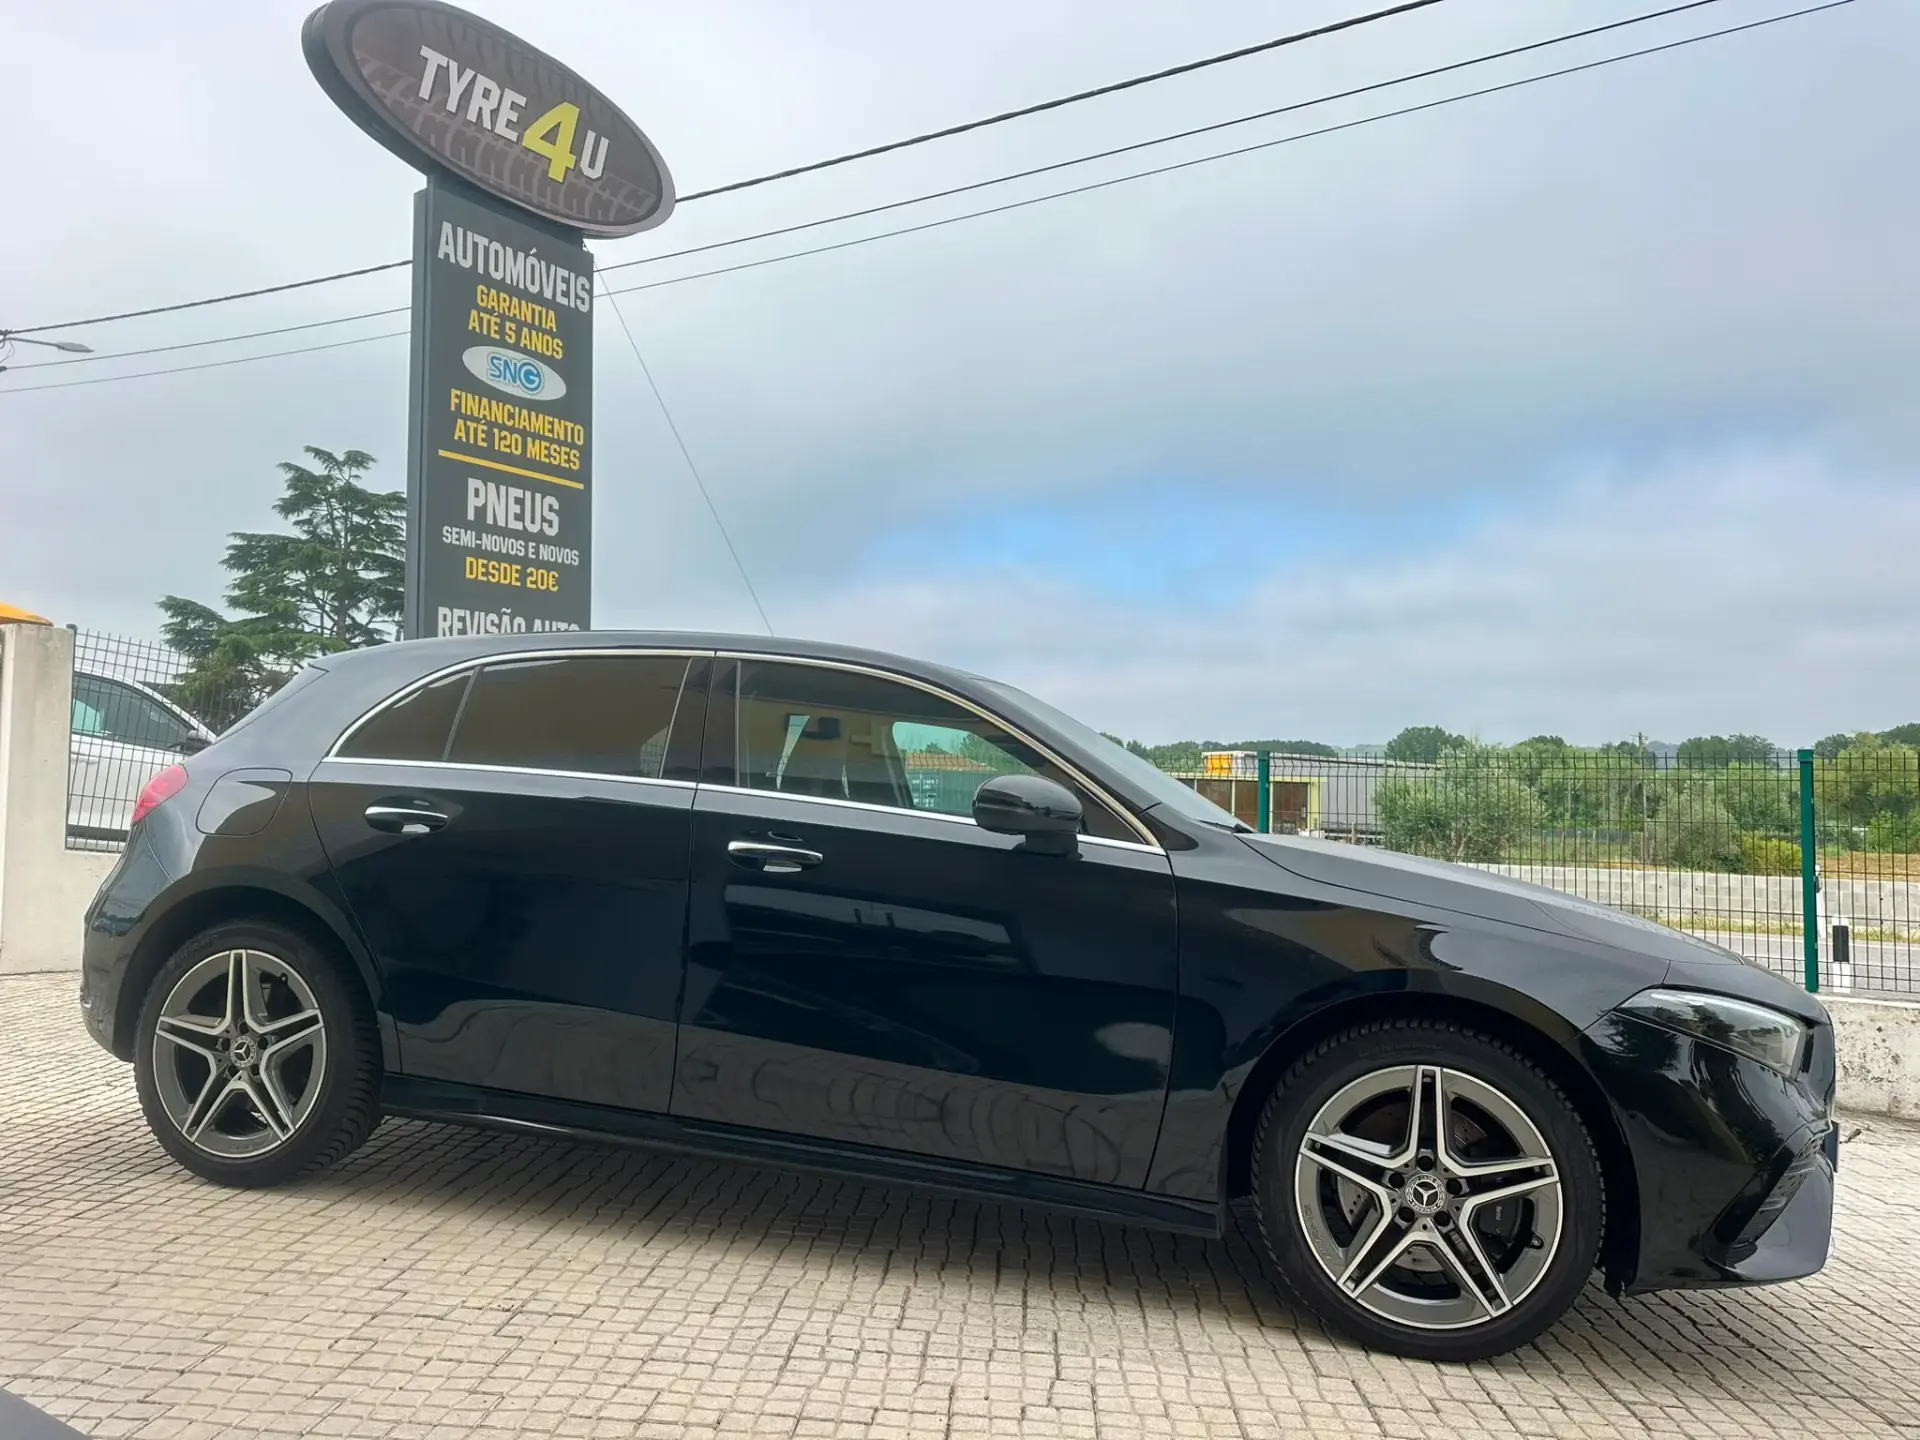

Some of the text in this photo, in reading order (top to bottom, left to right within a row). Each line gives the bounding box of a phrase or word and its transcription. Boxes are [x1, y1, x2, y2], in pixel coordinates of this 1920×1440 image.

[437, 220, 591, 313] AUTOMÓVEIS
[476, 284, 557, 333] GARANTIA
[467, 309, 564, 360] ATÉ 5 ANOS
[487, 353, 544, 394] SNG
[450, 388, 585, 446] FINANCIAMENTO
[453, 418, 580, 471] ATÉ 120 MESES
[466, 477, 560, 537] PNEUS
[442, 525, 580, 566] SEMI-NOVOS E NOVOS
[465, 556, 560, 592] DESDE 20€
